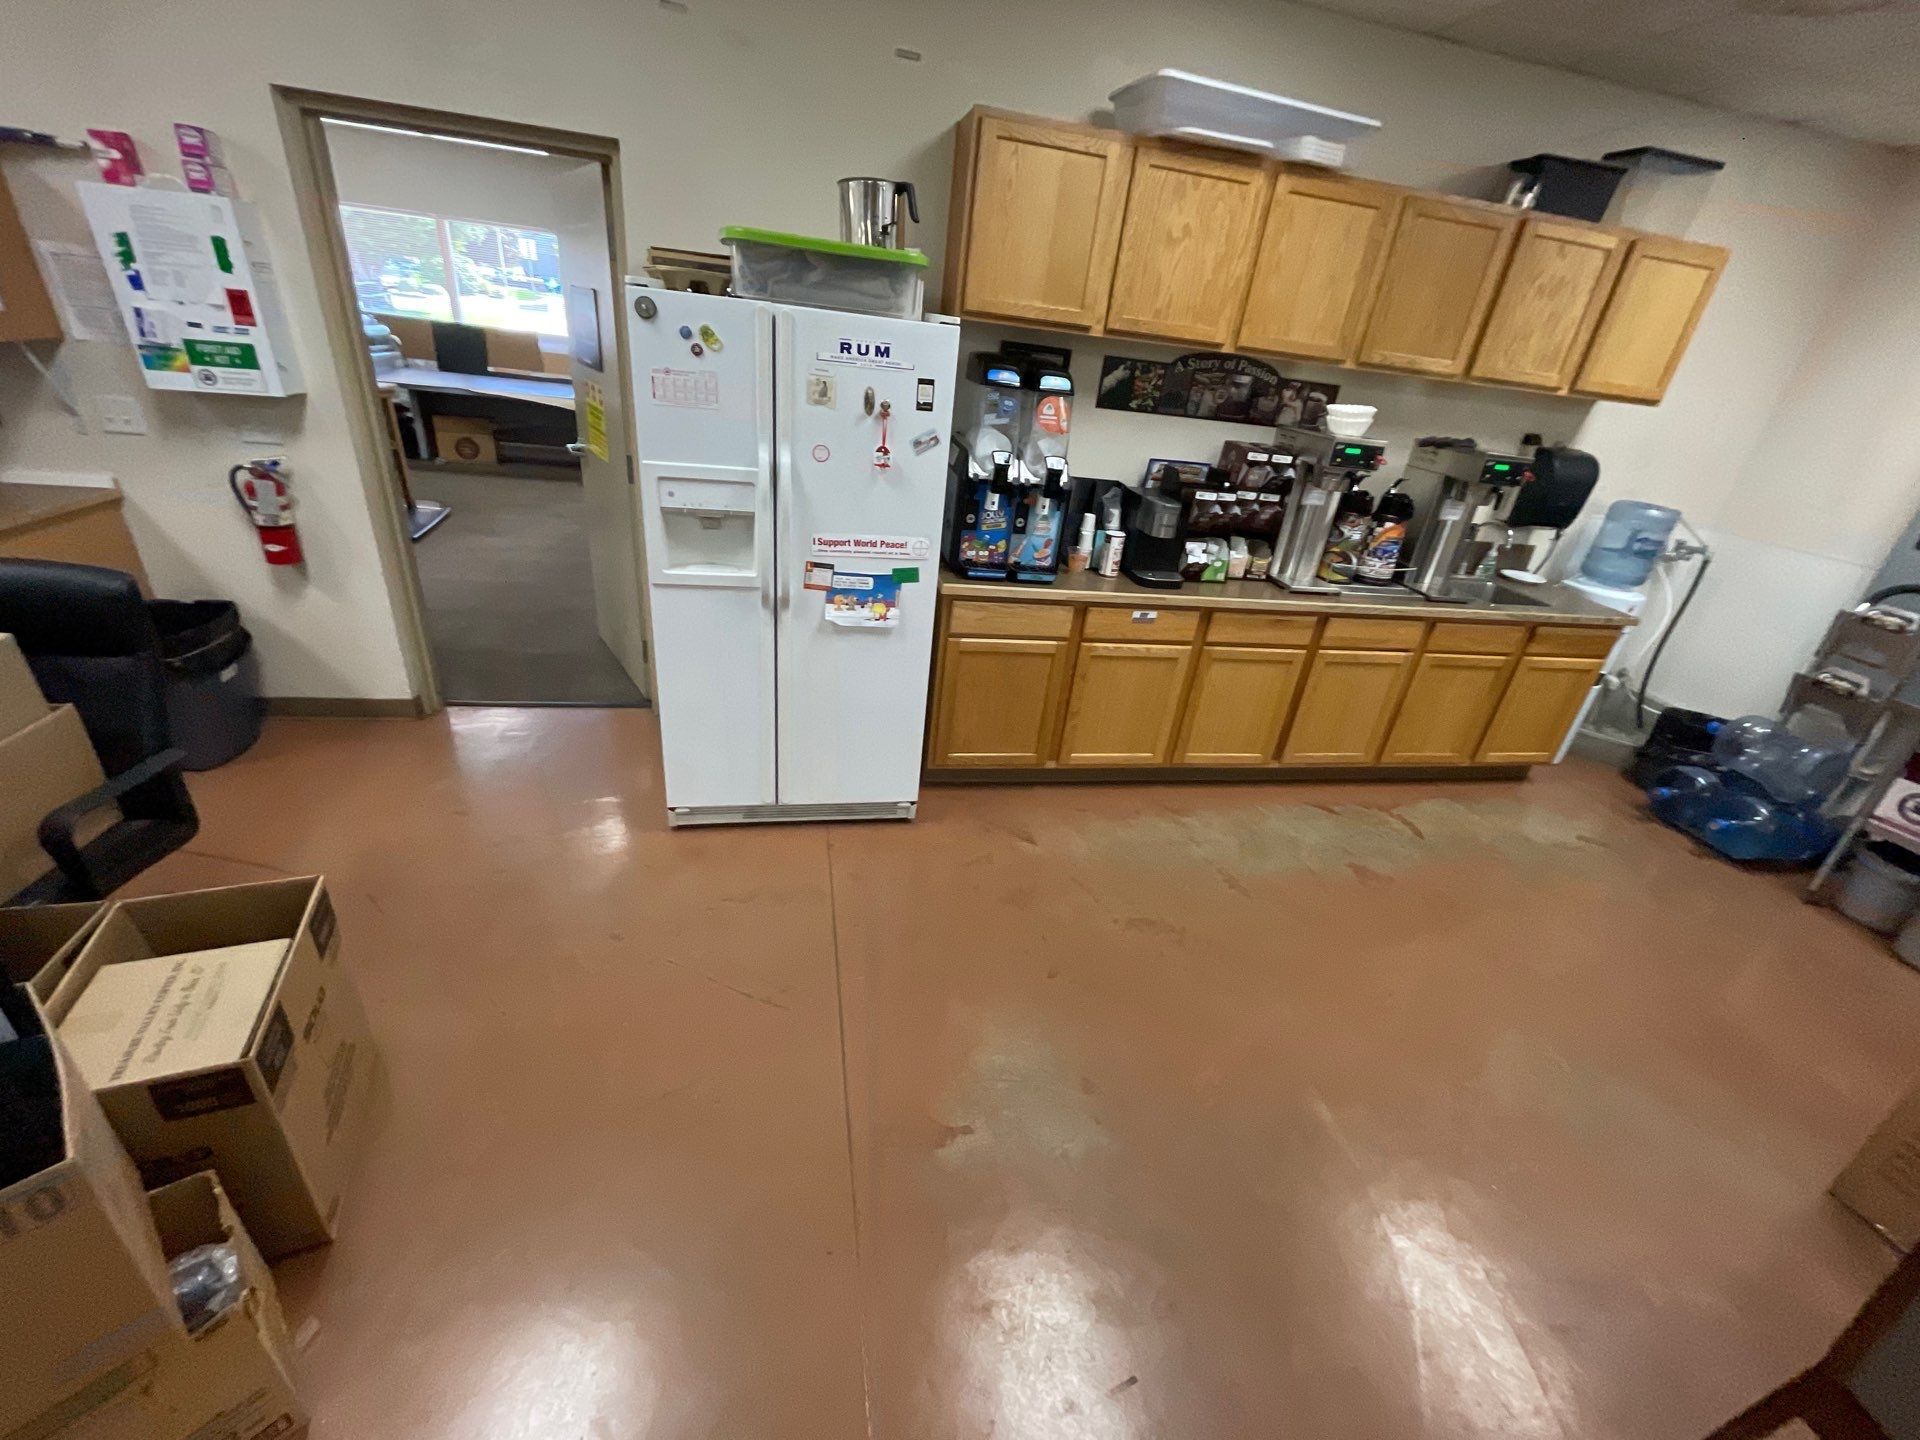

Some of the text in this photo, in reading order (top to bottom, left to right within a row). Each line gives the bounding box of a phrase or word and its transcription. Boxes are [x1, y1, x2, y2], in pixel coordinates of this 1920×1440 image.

[839, 341, 891, 359] RUM
[1175, 358, 1279, 385] A Story of Passion
[817, 537, 852, 548] Support
[853, 538, 878, 549] World
[879, 540, 908, 550] Peace!
